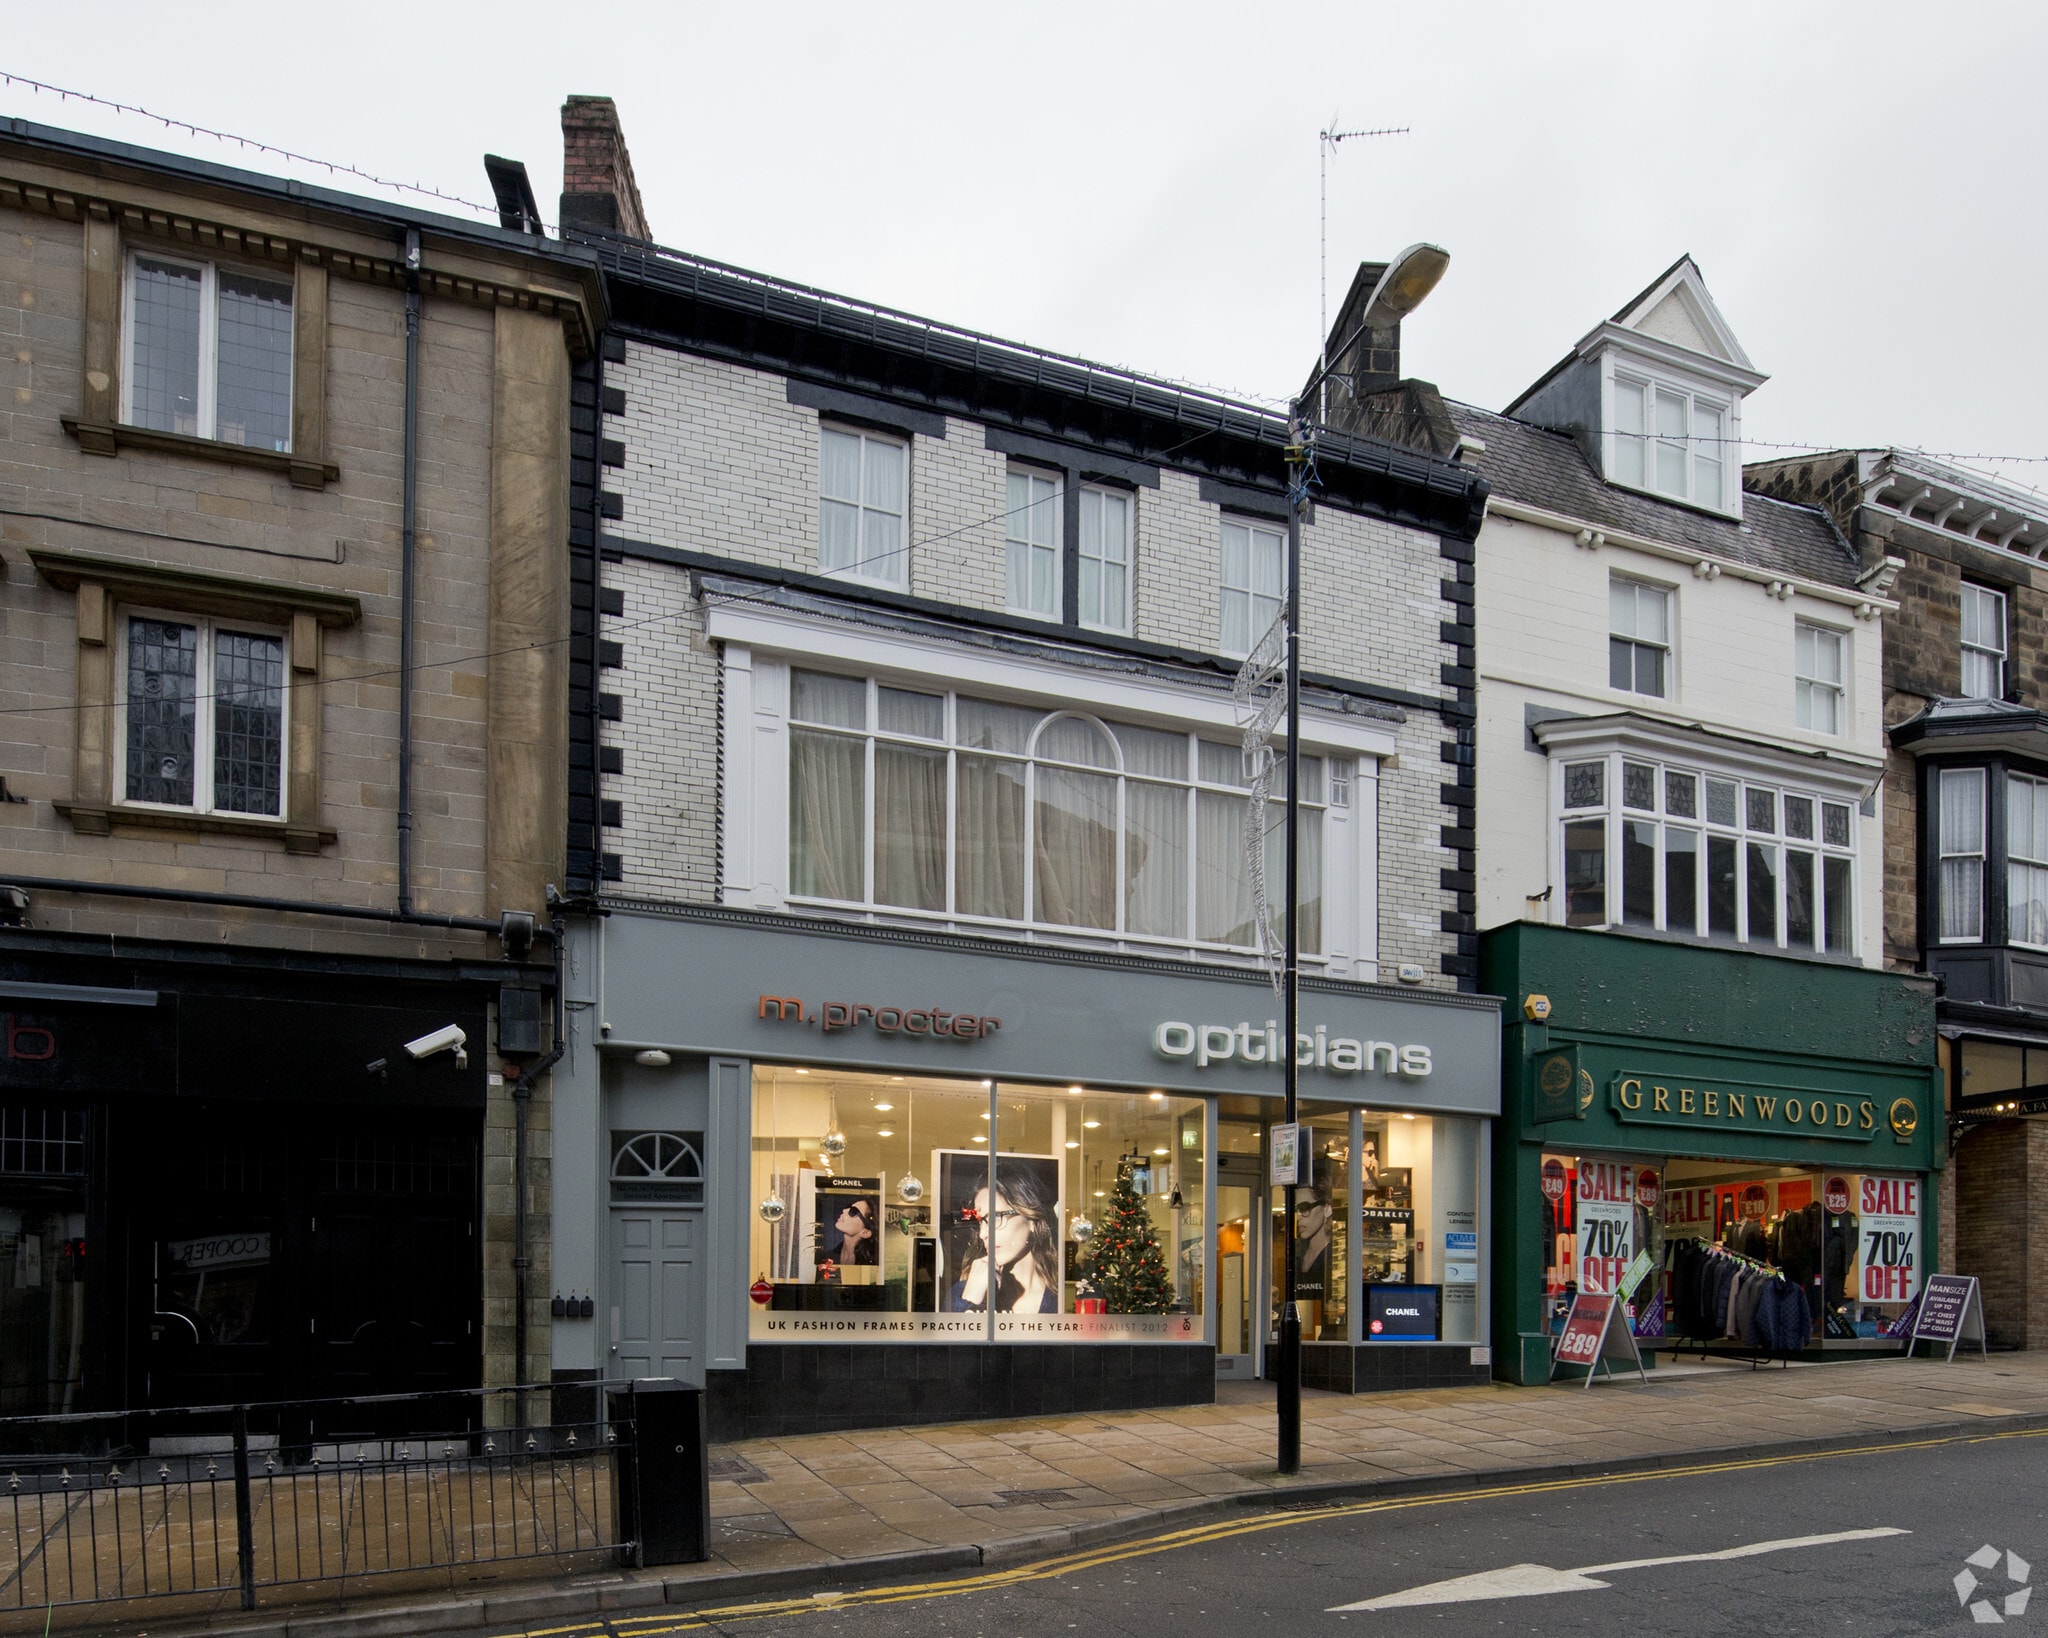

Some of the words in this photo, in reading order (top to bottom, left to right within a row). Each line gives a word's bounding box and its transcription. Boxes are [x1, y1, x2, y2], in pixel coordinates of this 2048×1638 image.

[8, 1014, 56, 1060] b
[1155, 1019, 1433, 1077] opticians
[1619, 1079, 1875, 1130] GREENWOODS
[832, 1179, 863, 1187] CHANEL
[1546, 1178, 1563, 1194] £49
[1580, 1162, 1632, 1203] SALE
[623, 1191, 652, 1200] Serviced
[653, 1192, 692, 1202] Apartments
[1641, 1187, 1658, 1202] £89
[1828, 1194, 1848, 1208] £25
[1862, 1178, 1916, 1216] SALE
[1369, 1210, 1411, 1219] OAKLEY
[1744, 1199, 1766, 1215] £10
[1873, 1219, 1906, 1227] GREENWOODS
[1583, 1219, 1629, 1258] 70%
[1865, 1231, 1914, 1266] 70%
[1583, 1256, 1629, 1294] OFF
[1865, 1265, 1914, 1299] OFF
[1929, 1284, 1968, 1296] MANSIZE
[1928, 1296, 1962, 1305] AVAILABLE
[1386, 1308, 1420, 1316] CHANEL
[1639, 1298, 1659, 1332] MANSIZE
[1937, 1312, 1956, 1320] CHEST
[768, 1321, 786, 1330] UK
[794, 1321, 856, 1331] FASHION
[864, 1321, 914, 1331] FRAMES
[921, 1322, 982, 1331] PRACTICE
[998, 1322, 1015, 1331] OF
[1020, 1322, 1043, 1331] THE
[1049, 1322, 1084, 1331] YEAR:
[1089, 1322, 1136, 1331] FINALIST
[1142, 1323, 1169, 1332] 2012
[1931, 1325, 1955, 1333] COLLAR
[1561, 1332, 1598, 1355] £89
